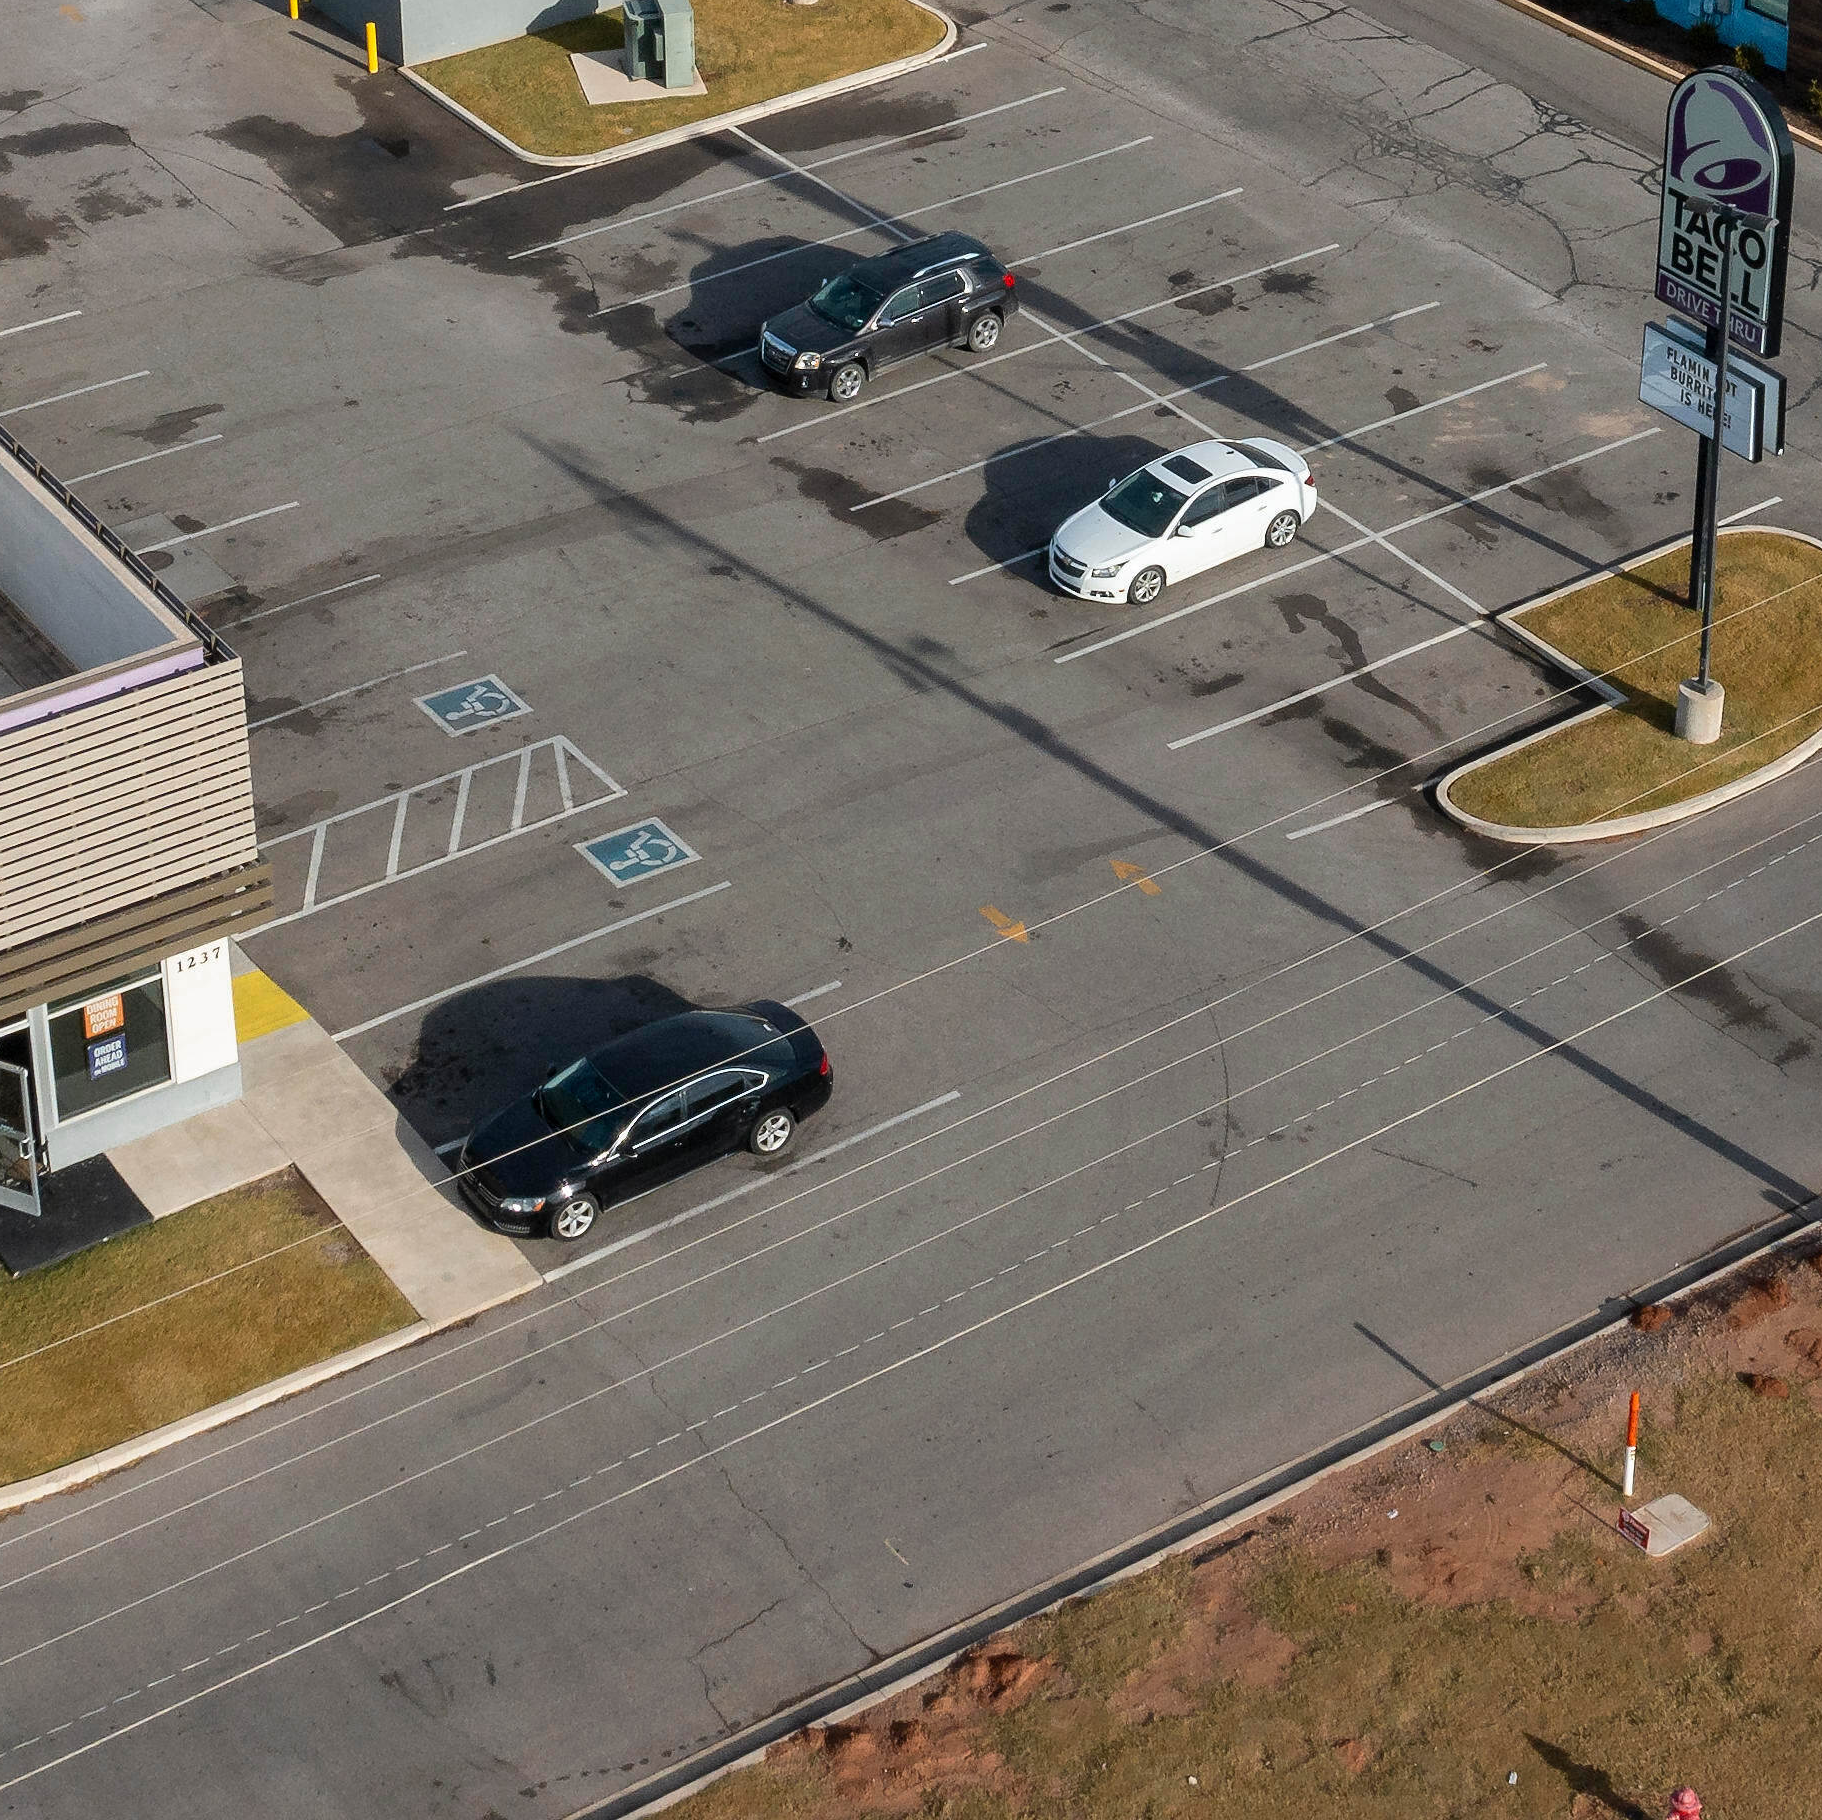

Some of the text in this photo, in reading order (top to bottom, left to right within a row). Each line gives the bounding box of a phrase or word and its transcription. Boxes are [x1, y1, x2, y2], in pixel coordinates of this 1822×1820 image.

[1668, 187, 1767, 270] TACO
[1671, 231, 1761, 315] BEL
[1666, 281, 1710, 318] DRIVE
[1667, 346, 1710, 382] FLAMIN
[1670, 366, 1715, 401] BURRIT
[1680, 388, 1732, 429] IS HEE!
[177, 946, 221, 973] 1237
[86, 996, 119, 1015] DINING
[90, 1007, 118, 1024] ROOM
[91, 1019, 117, 1034] OPEN
[93, 1040, 122, 1058] ORDER
[94, 1049, 123, 1068] AHEAD
[102, 1058, 126, 1073] MOBILE
